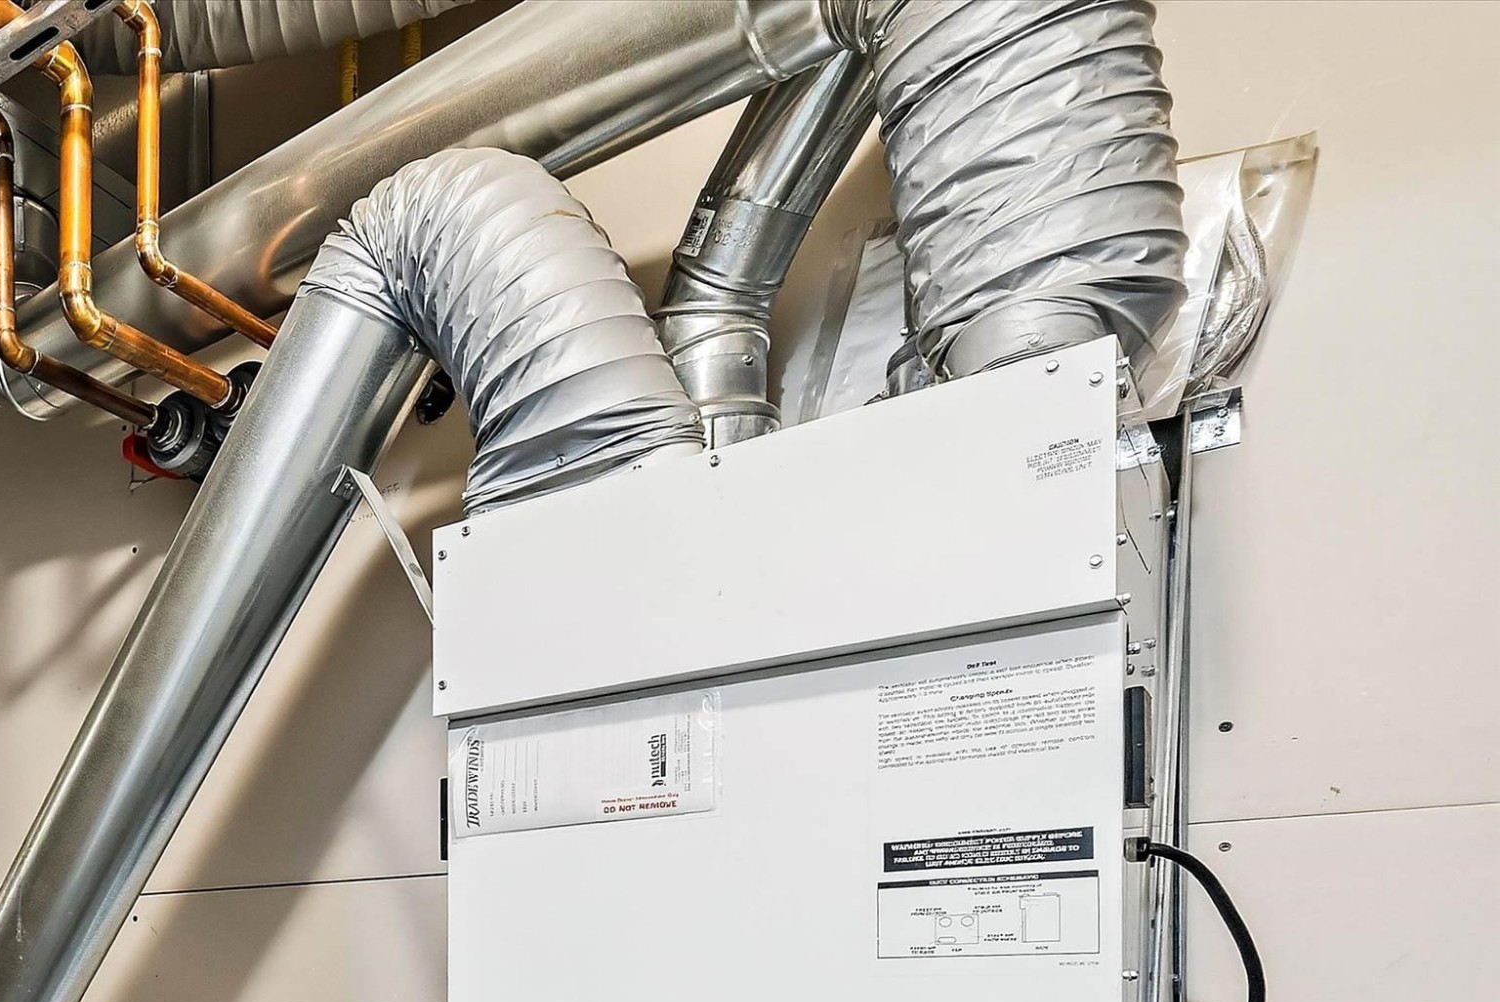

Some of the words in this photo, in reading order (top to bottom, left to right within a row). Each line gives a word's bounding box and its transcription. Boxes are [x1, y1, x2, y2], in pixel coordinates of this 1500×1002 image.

[465, 739, 481, 828] TRADEWINDS
[619, 804, 636, 812] NOT
[639, 800, 677, 810] REMOVE
